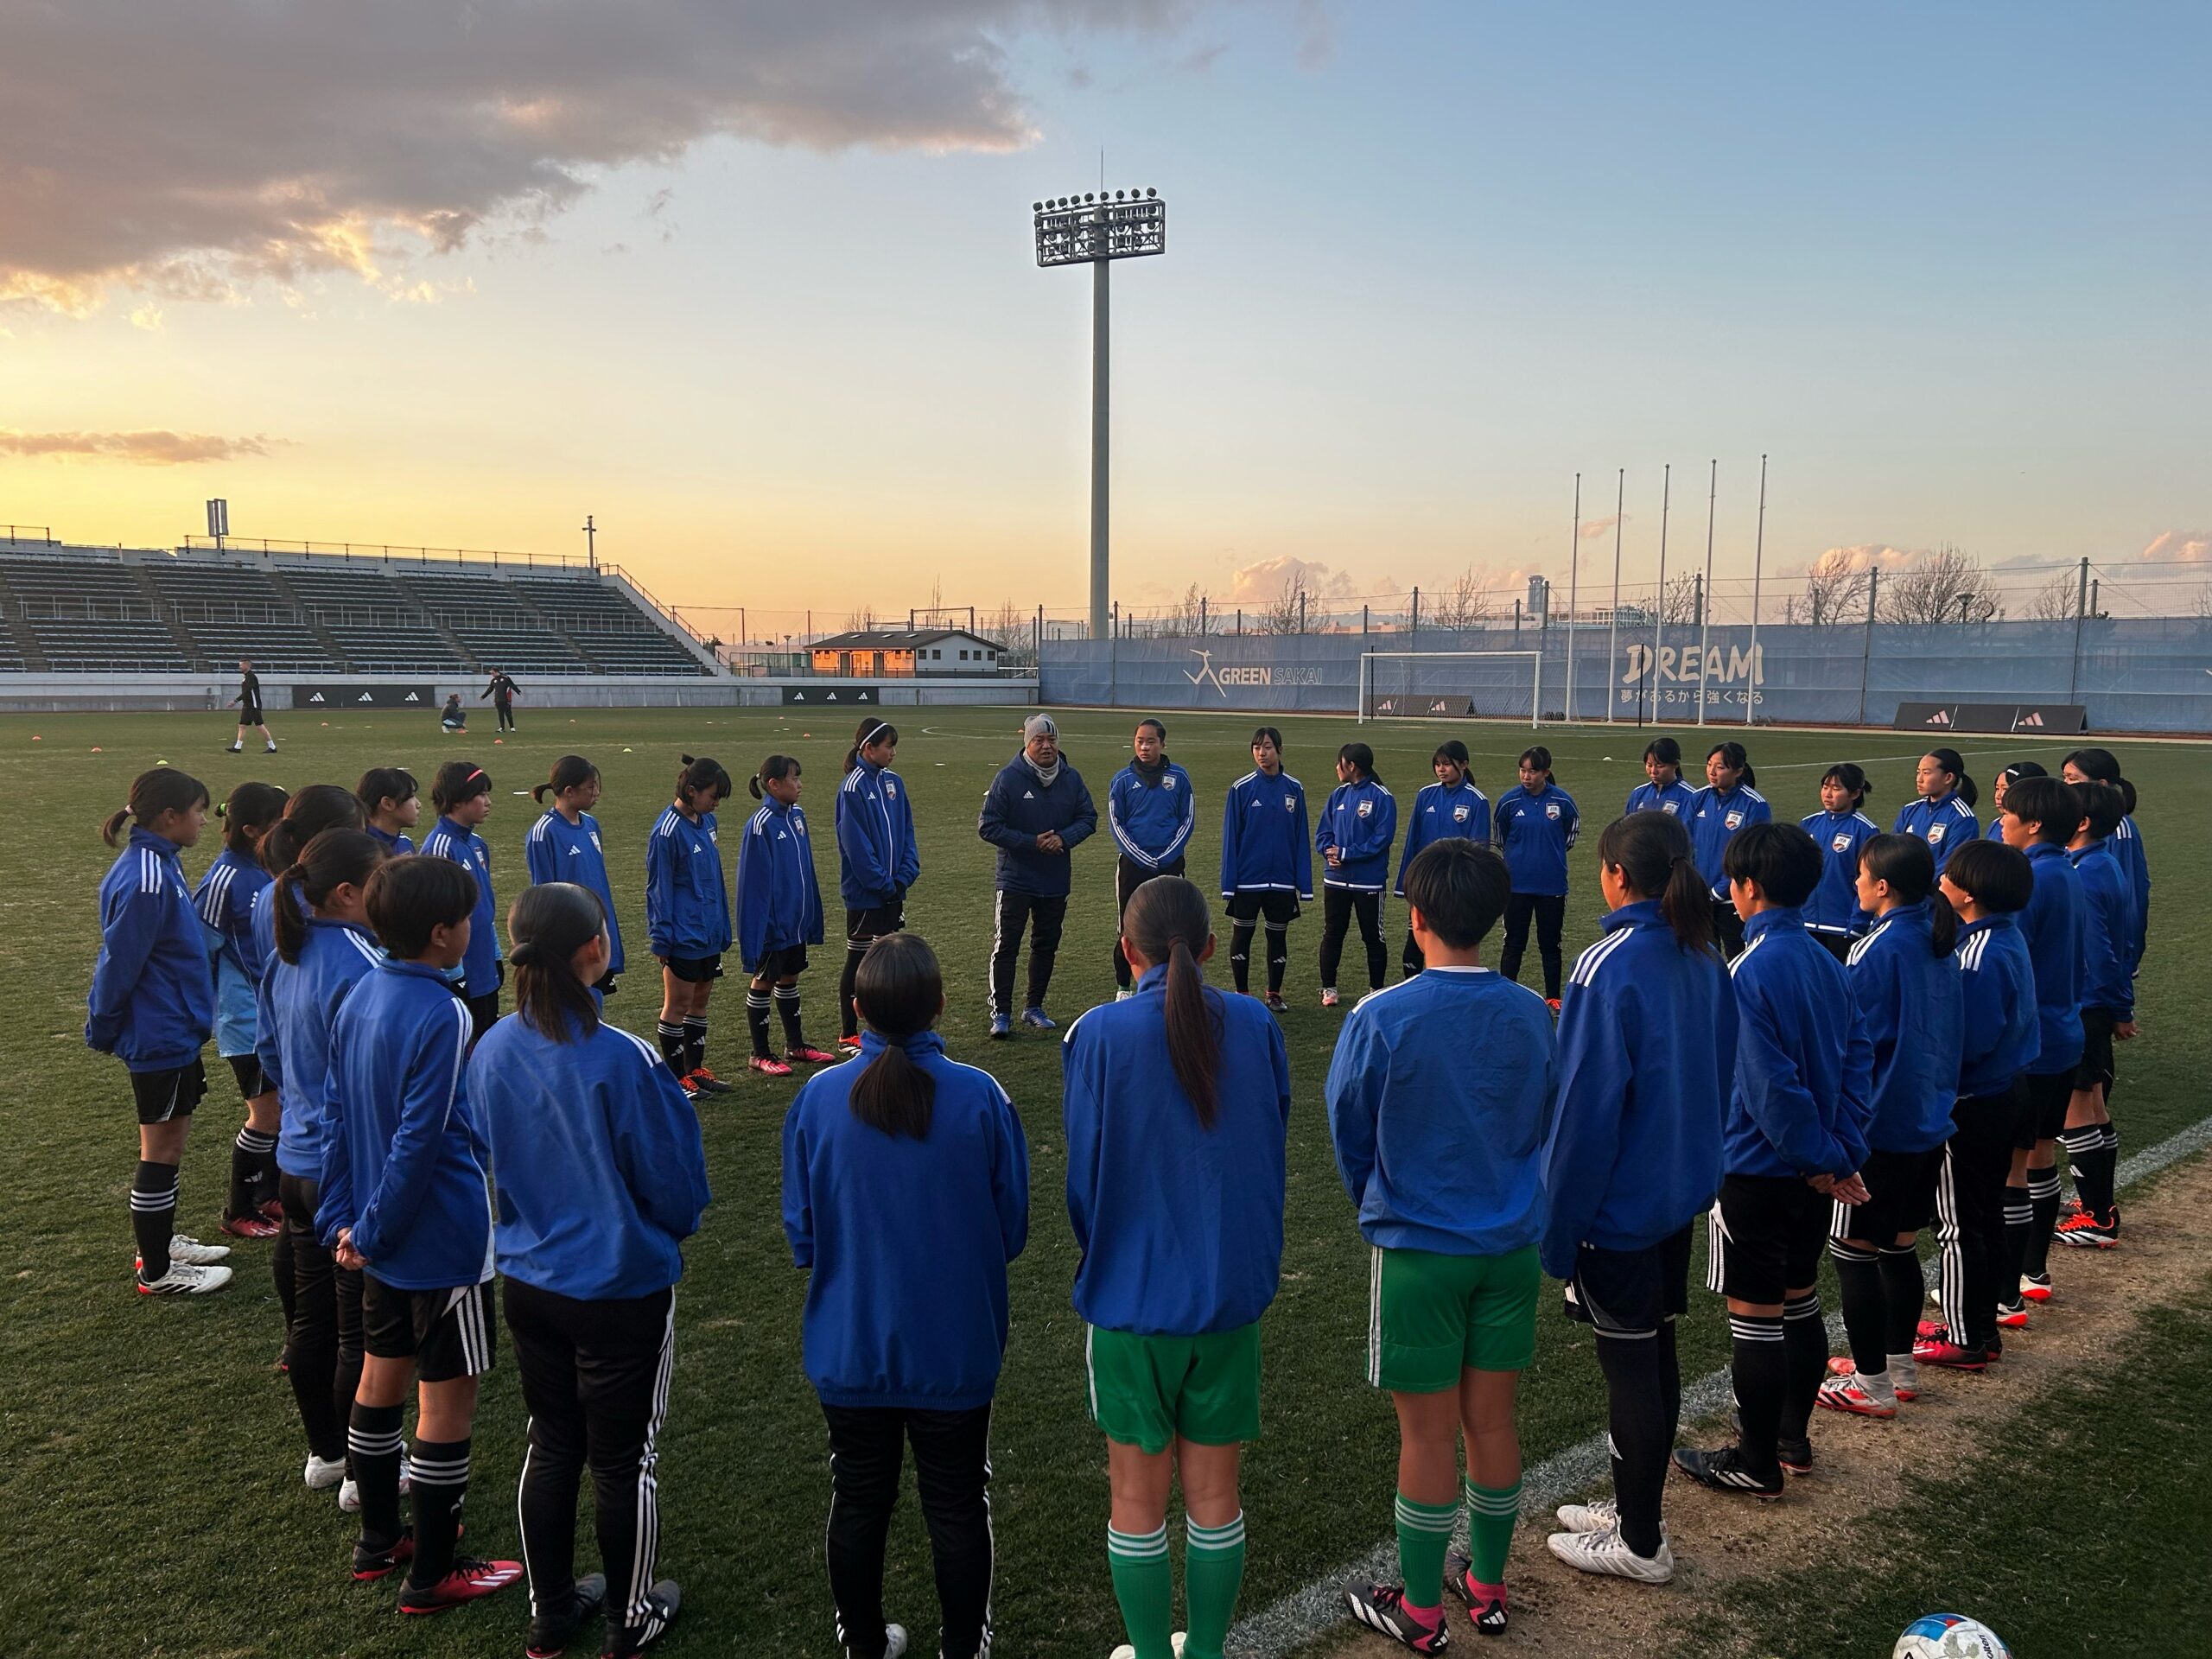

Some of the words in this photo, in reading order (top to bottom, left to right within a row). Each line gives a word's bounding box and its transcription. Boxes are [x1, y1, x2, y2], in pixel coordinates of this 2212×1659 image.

[1218, 667, 1272, 685] GREEN
[1274, 667, 1323, 685] SAKAI
[1622, 642, 1764, 685] DREAM
